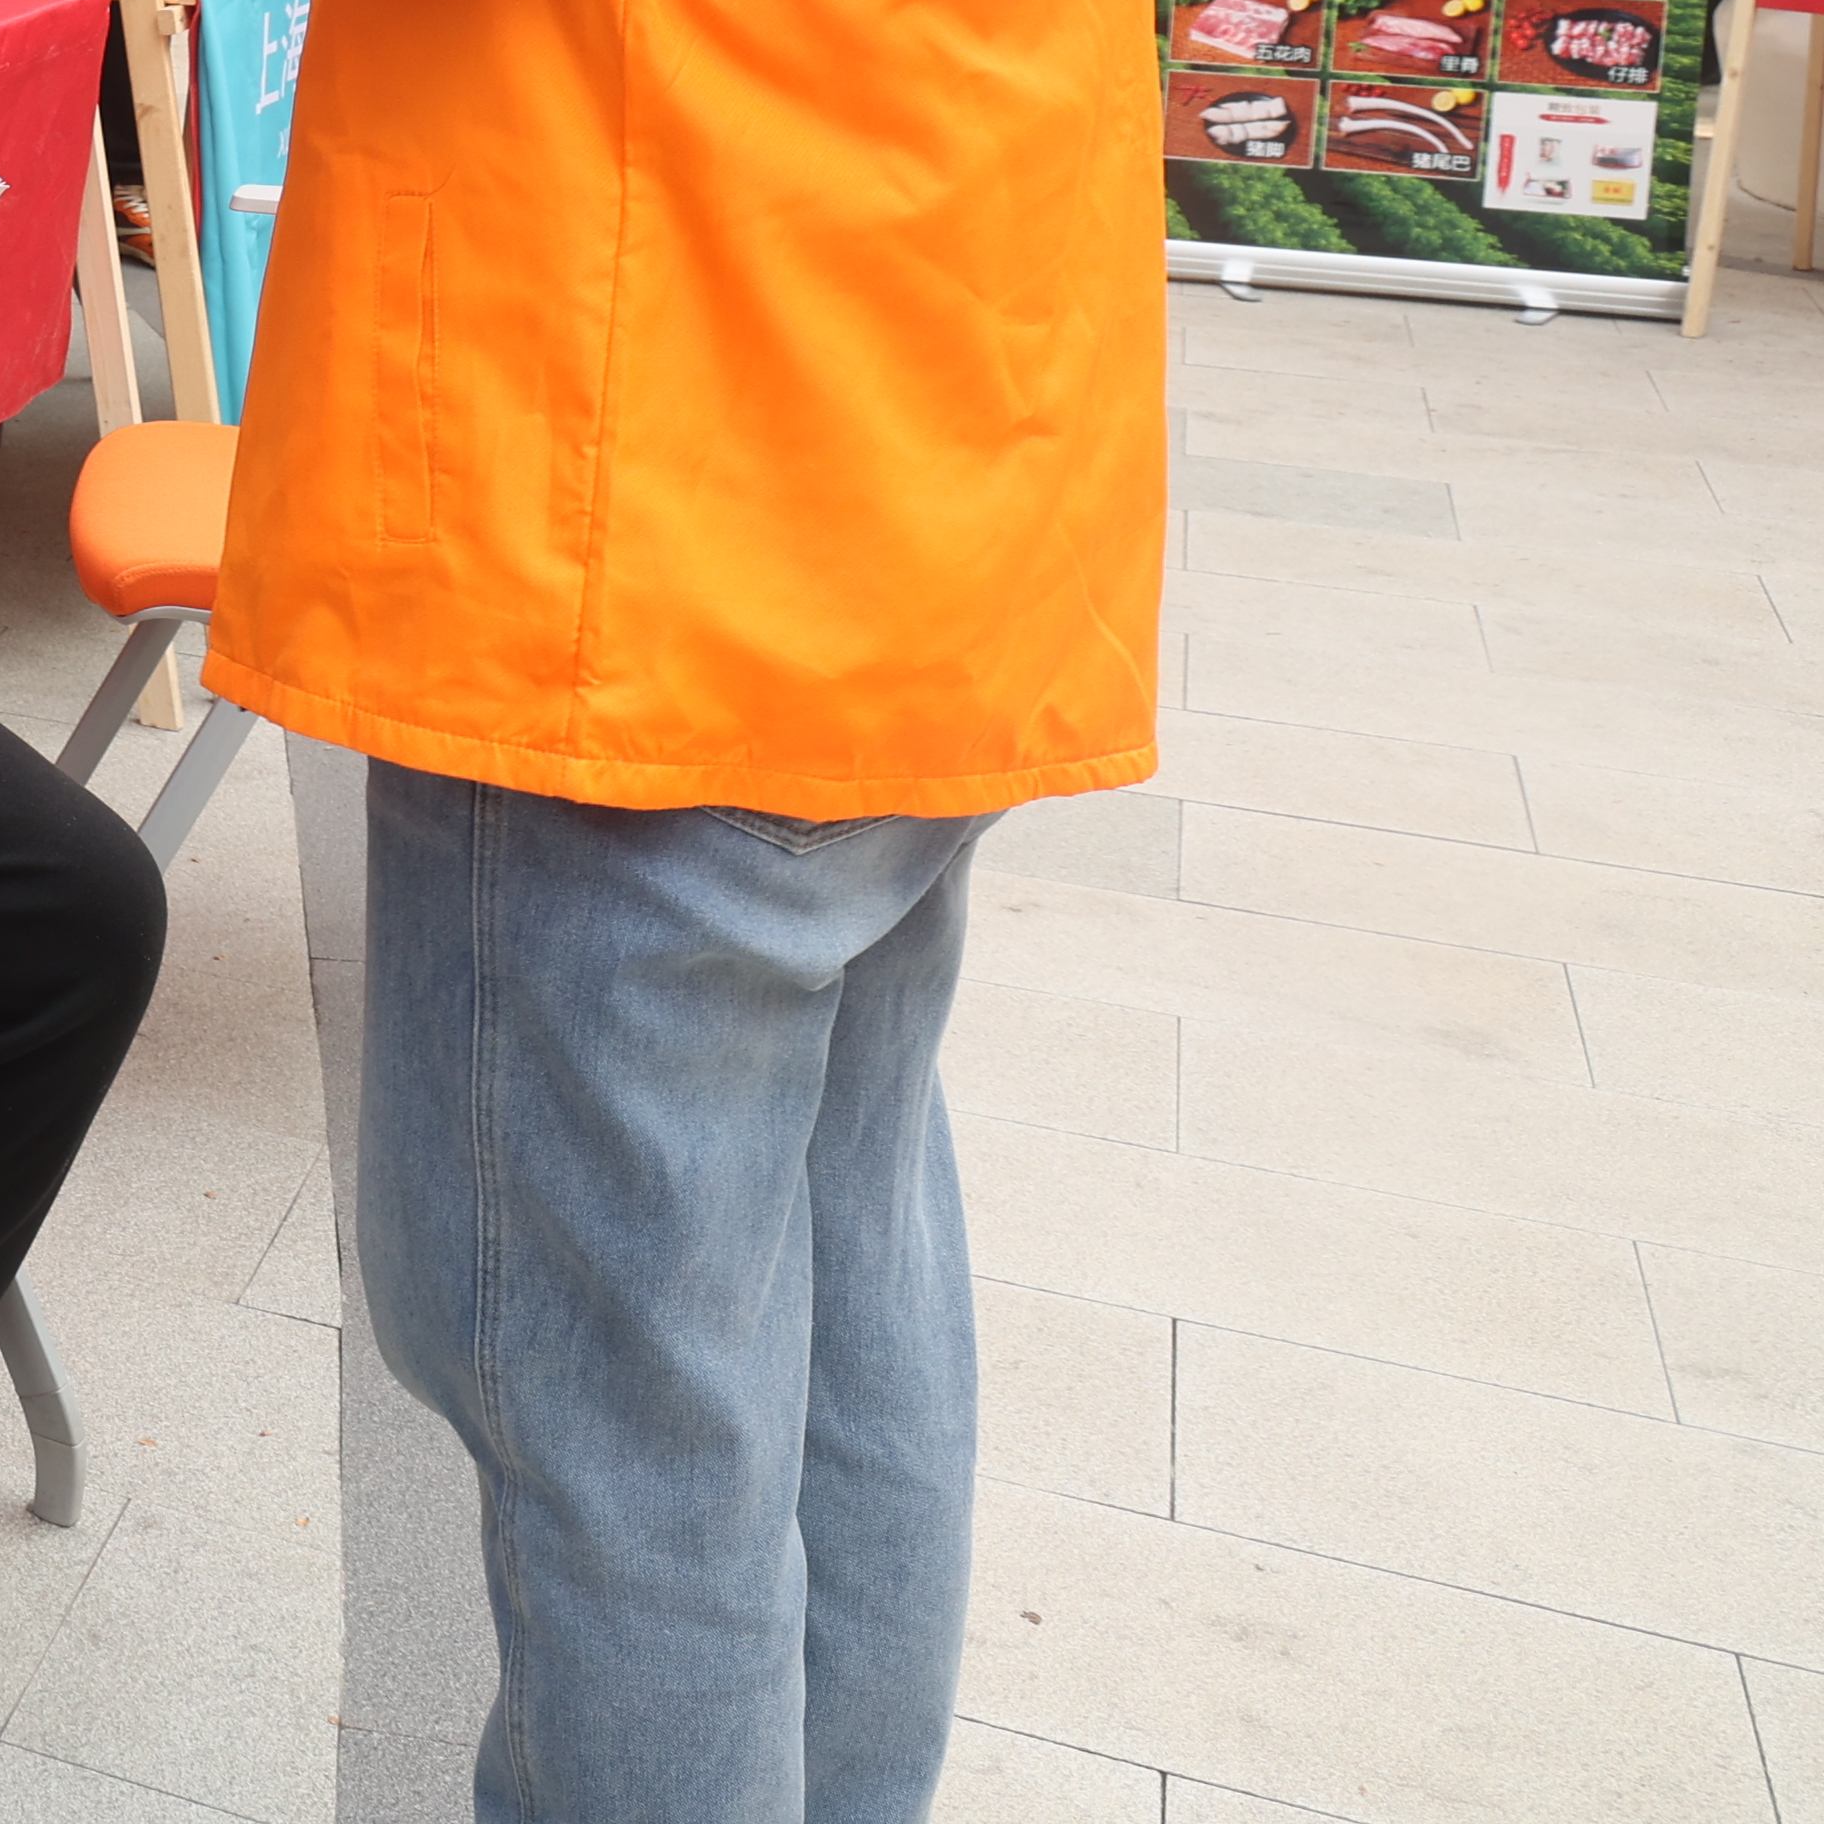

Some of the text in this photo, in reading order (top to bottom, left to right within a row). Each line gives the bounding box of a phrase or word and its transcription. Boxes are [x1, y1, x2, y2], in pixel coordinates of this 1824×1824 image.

[1255, 43, 1313, 64] 五花肉
[1412, 151, 1471, 172] 猪尾巴
